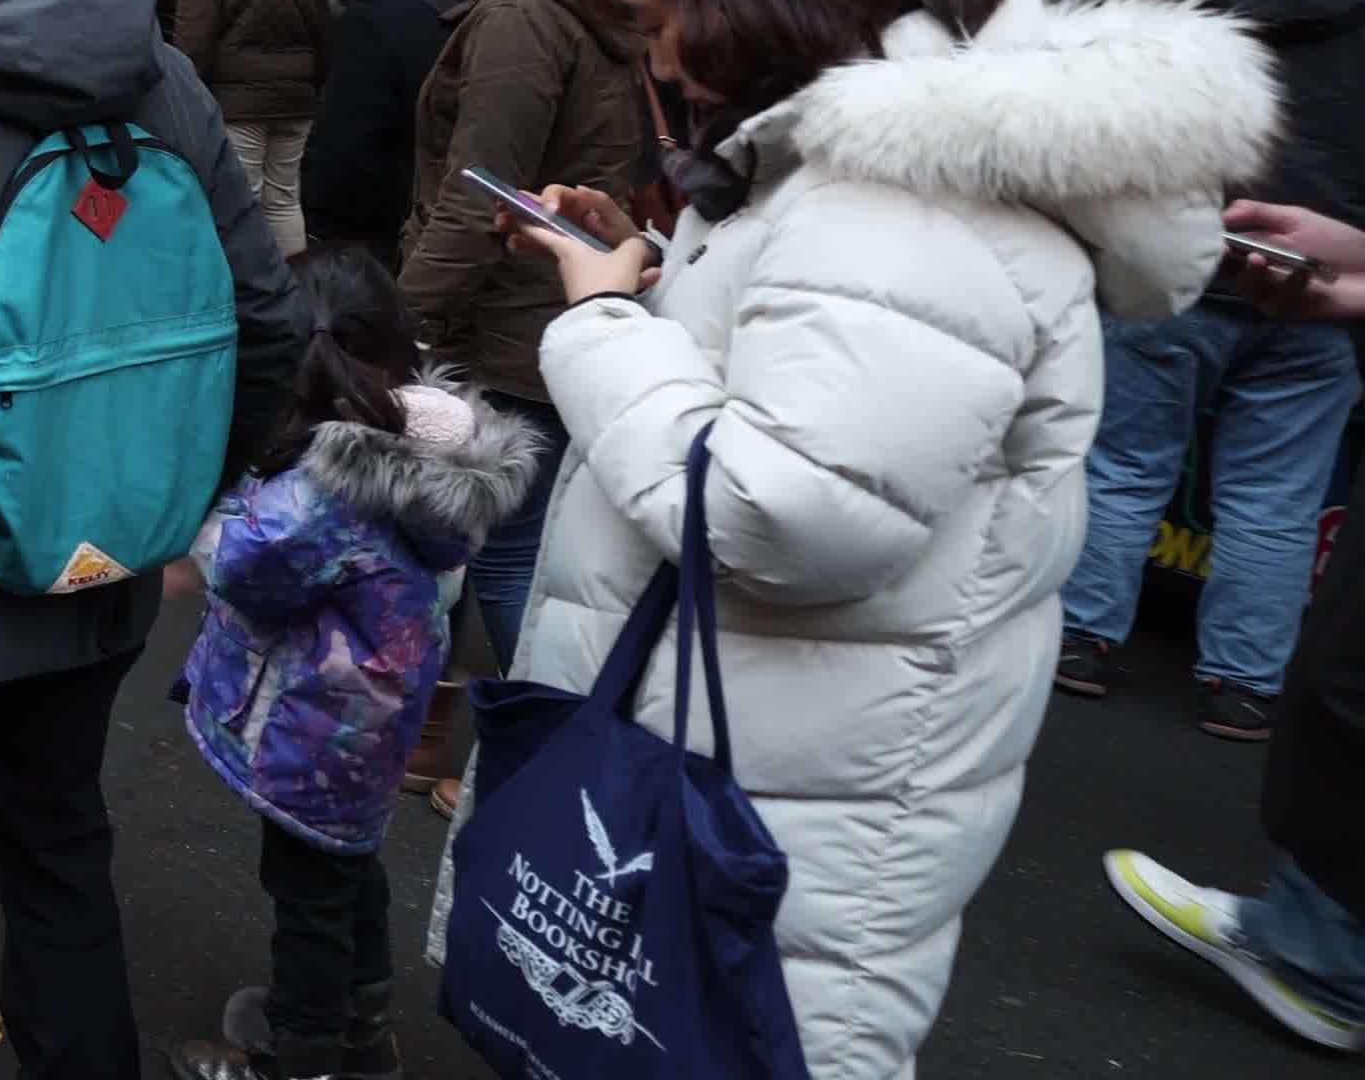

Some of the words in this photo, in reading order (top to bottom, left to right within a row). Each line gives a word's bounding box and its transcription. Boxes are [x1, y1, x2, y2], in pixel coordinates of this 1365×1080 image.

[68, 571, 109, 586] KELTY
[507, 852, 623, 950] NOTTING
[573, 870, 633, 923] THE
